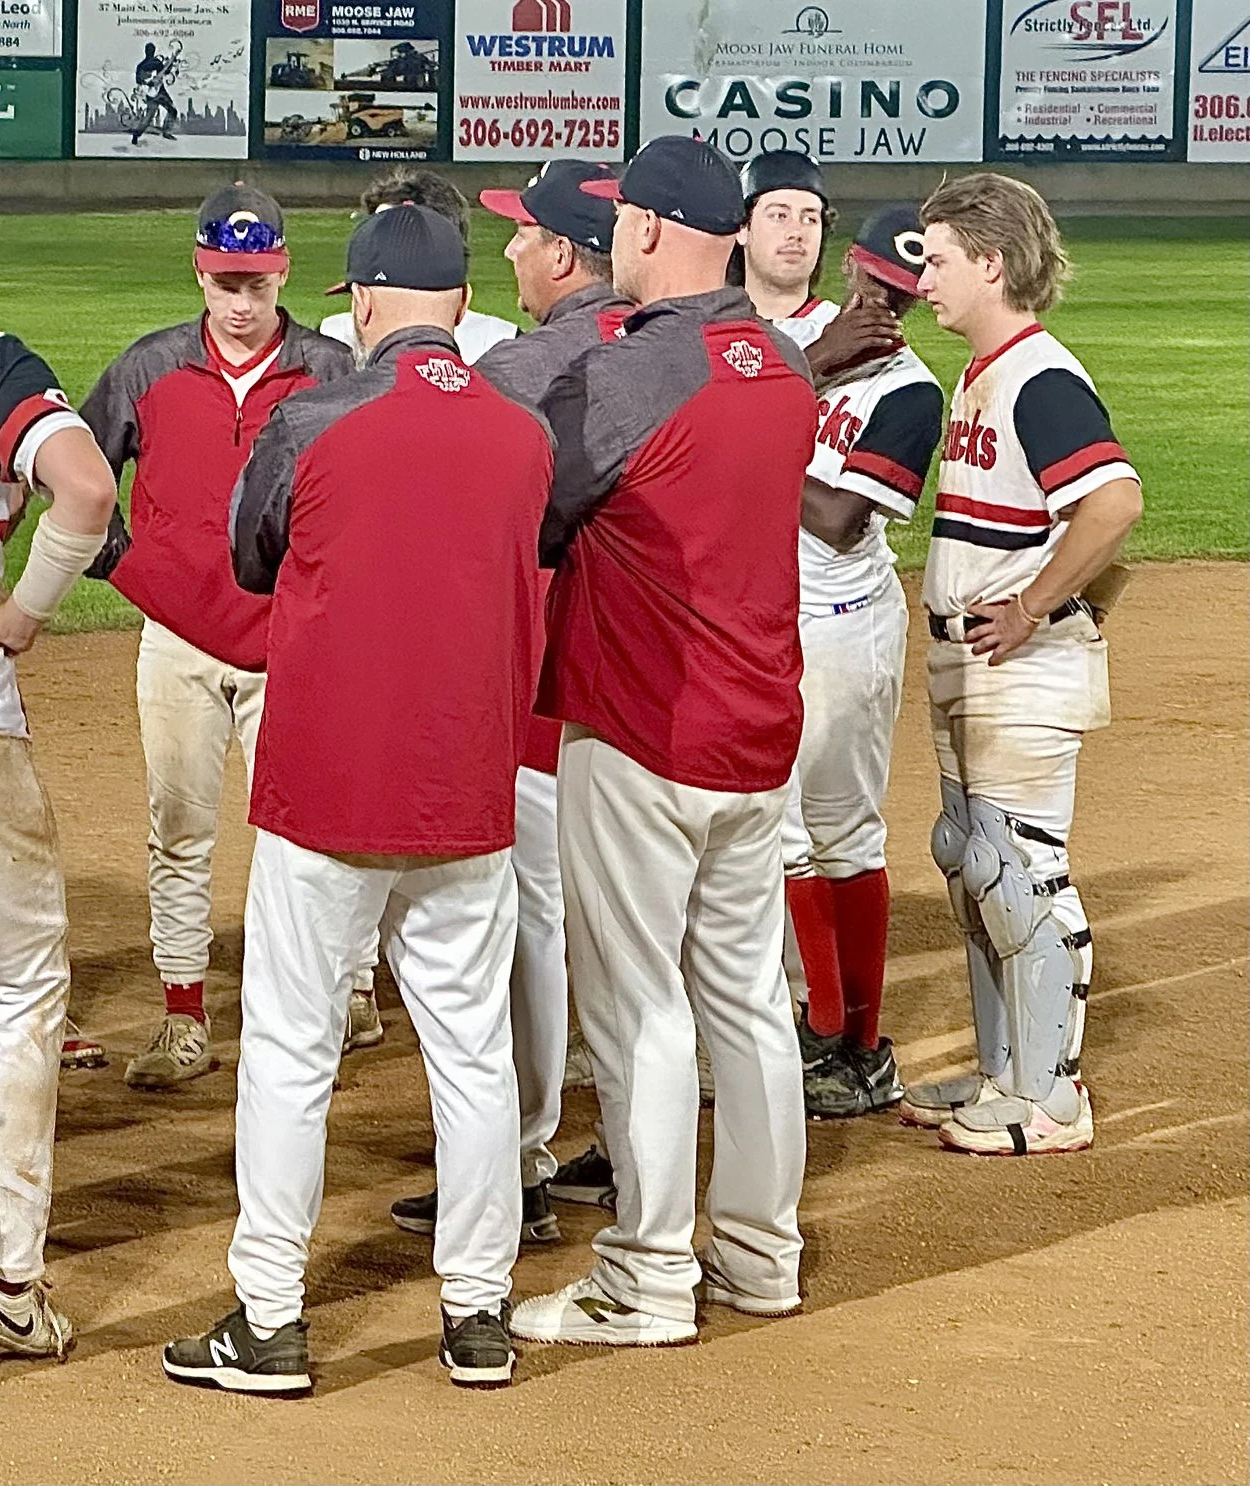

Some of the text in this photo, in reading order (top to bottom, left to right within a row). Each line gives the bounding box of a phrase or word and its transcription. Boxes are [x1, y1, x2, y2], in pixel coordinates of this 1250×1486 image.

[98, 3, 110, 12] 37
[113, 3, 136, 13] Main
[137, 4, 150, 13] St.
[152, 4, 162, 14] N.
[166, 4, 192, 14] Moose
[216, 5, 230, 14] SK
[285, 6, 316, 17] RME
[331, 6, 415, 18] MOOSE JAW
[2, 19, 31, 29] North
[1024, 17, 1074, 34] Strictly
[1129, 18, 1155, 31] Ltd.
[1069, 1, 1144, 41] SFL
[466, 35, 615, 58] WESTRUM
[490, 60, 592, 73] TIMBER MART
[1015, 71, 1161, 83] THE FENCING SPECIALISTS
[459, 90, 621, 110] www.westrumlumber.com
[664, 79, 960, 119] CASINO
[1025, 103, 1157, 114] Residential Commercial
[1024, 115, 1157, 126] Industrial Recreational
[458, 117, 620, 149] 306-692-7255
[853, 127, 927, 156] JAW
[372, 150, 427, 160] NEW HOLLAND
